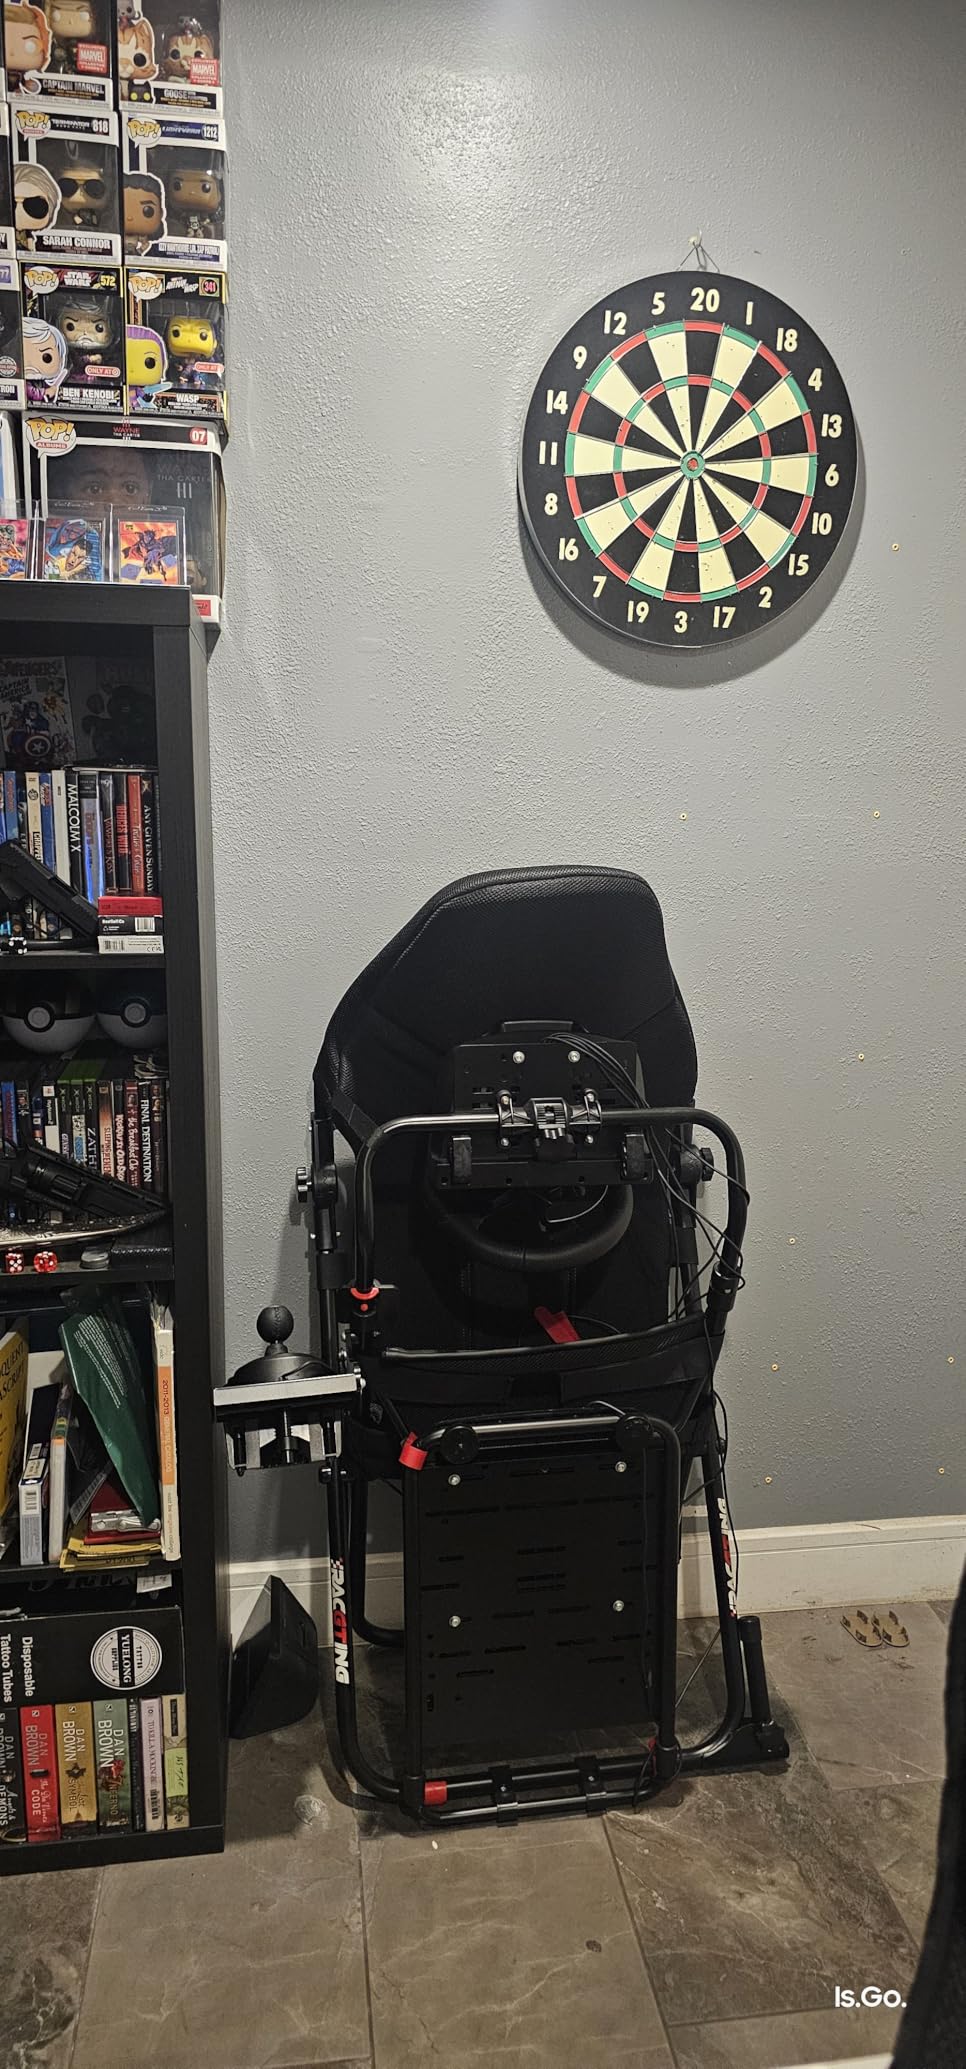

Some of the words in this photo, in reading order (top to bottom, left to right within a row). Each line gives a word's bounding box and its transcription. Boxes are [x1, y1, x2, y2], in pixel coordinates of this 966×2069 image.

[80, 50, 104, 62] MARVEL
[192, 65, 215, 75] MARVEL
[42, 79, 73, 91] CAPTAIN
[75, 81, 105, 94] MARVEL
[164, 89, 188, 98] GOOSE
[16, 111, 49, 130] POP!
[51, 119, 90, 127] TERMINATOR
[92, 120, 108, 133] 818
[127, 119, 160, 138] POP!
[203, 126, 218, 138] 1212
[42, 235, 73, 246] SARAH
[74, 238, 111, 249] CONNOR
[25, 270, 58, 288] POP!
[100, 275, 116, 287] 572
[128, 276, 162, 293] POP!
[204, 281, 216, 292] 341
[651, 291, 666, 316] 5
[689, 286, 720, 313] 20
[603, 309, 628, 336] 12
[745, 301, 754, 326] 1
[776, 327, 798, 353] 18
[573, 345, 588, 370] 9
[87, 366, 104, 374] ONLY
[104, 367, 113, 375] AT
[807, 367, 823, 392] 4
[63, 387, 80, 397] BEN
[83, 389, 114, 400] KENOBI
[176, 393, 200, 403] WASP
[546, 389, 569, 415] 14
[25, 417, 75, 442] POP!
[112, 426, 141, 434] WAYNE
[192, 430, 206, 440] 07
[821, 413, 843, 439] 13
[538, 440, 558, 466] 11
[824, 463, 840, 487] 6
[176, 482, 193, 499] III
[544, 492, 558, 516] 8
[811, 511, 833, 536] 10
[558, 537, 579, 562] 16
[788, 553, 809, 576] 15
[592, 575, 607, 598] 7
[758, 586, 773, 609] 2
[627, 600, 650, 624] 19
[673, 610, 688, 634] 3
[712, 605, 736, 629] 17
[67, 784, 81, 842] MALCOLM
[116, 805, 128, 833] DEUCES
[144, 804, 152, 823] ANY
[70, 844, 82, 852] X
[117, 834, 129, 854] WILD
[144, 826, 154, 857] GIVEN
[145, 857, 154, 893] SUNDAY
[141, 1099, 150, 1125] FINAL
[104, 1127, 112, 1152] SLEEPING
[128, 1128, 140, 1158] Breakfast
[116, 1149, 125, 1165] OLD
[128, 1158, 139, 1170] Club
[141, 1126, 153, 1183] DESTINATION
[162, 1380, 170, 1415] 2011-2013
[0, 1633, 11, 1669] Tattoo
[121, 1634, 132, 1683] YUELONG
[21, 1636, 36, 1697] Disposable
[2, 1669, 14, 1703] Tubes
[5, 1736, 15, 1759] DAN
[25, 1724, 40, 1766] BROWN
[39, 1733, 48, 1756] DAN
[63, 1720, 77, 1762] BROWN
[75, 1728, 86, 1752] DAN
[98, 1720, 114, 1768] BROWN
[113, 1729, 125, 1756] DAN
[0, 1785, 8, 1825] DEMONS
[31, 1789, 41, 1816] CODE
[68, 1779, 77, 1813] SYMBOL
[108, 1775, 123, 1816] INFERNO
